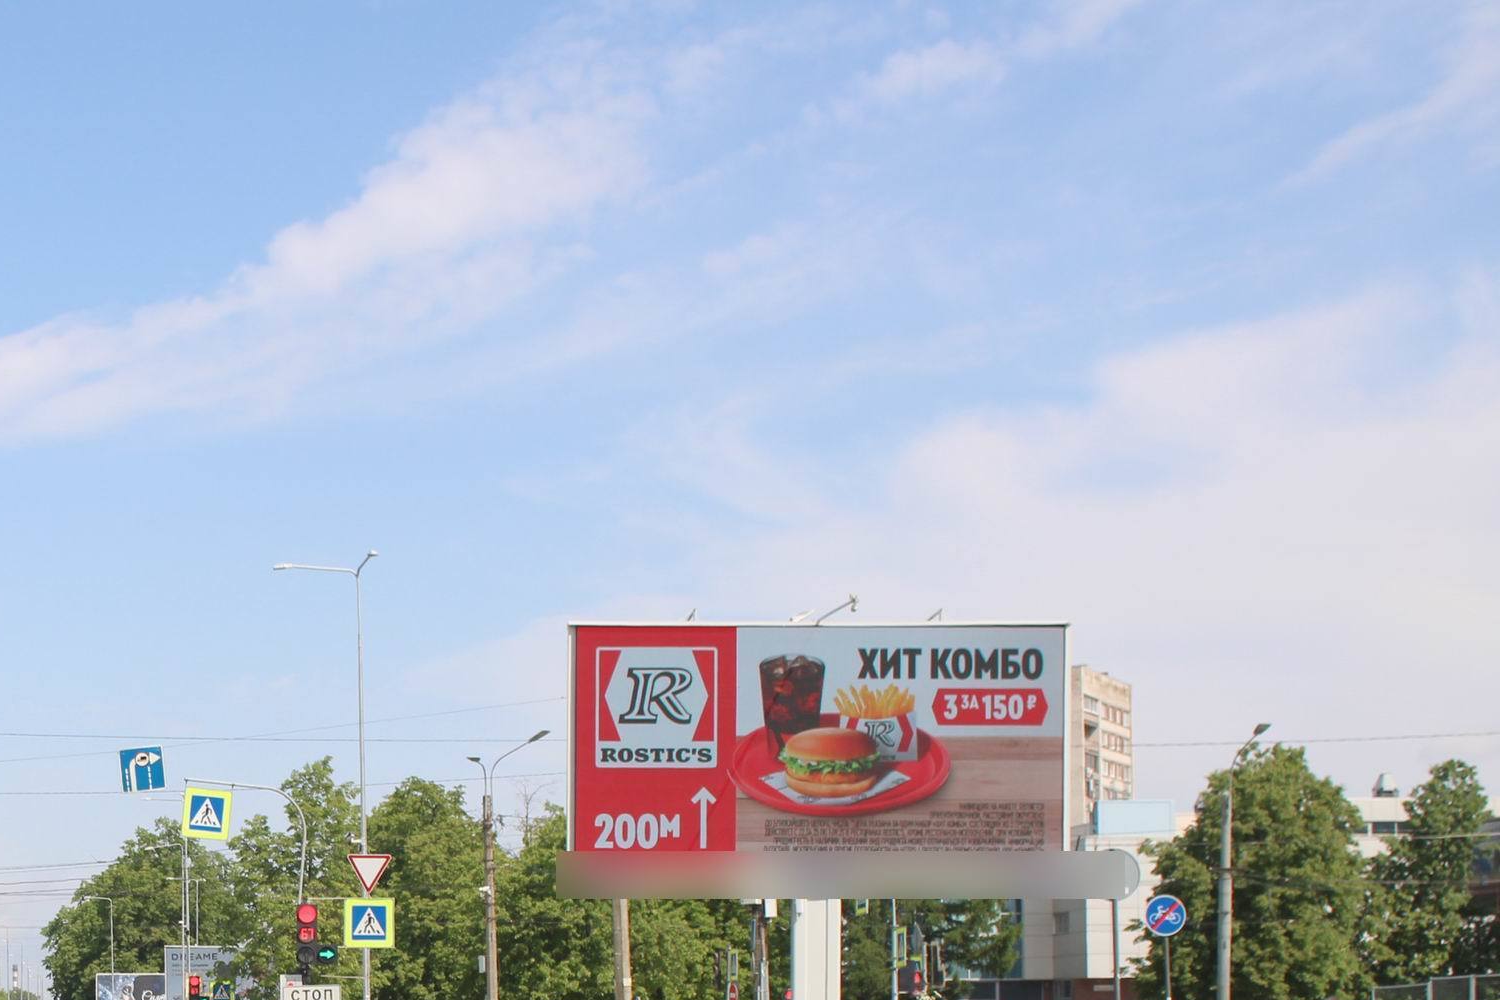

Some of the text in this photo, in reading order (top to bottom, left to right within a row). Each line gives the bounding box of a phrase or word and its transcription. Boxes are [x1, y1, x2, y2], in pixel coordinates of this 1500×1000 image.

[857, 647, 1044, 681] ХИТ КОМБО
[618, 667, 693, 725] R
[600, 747, 713, 764] ROSTIC'S
